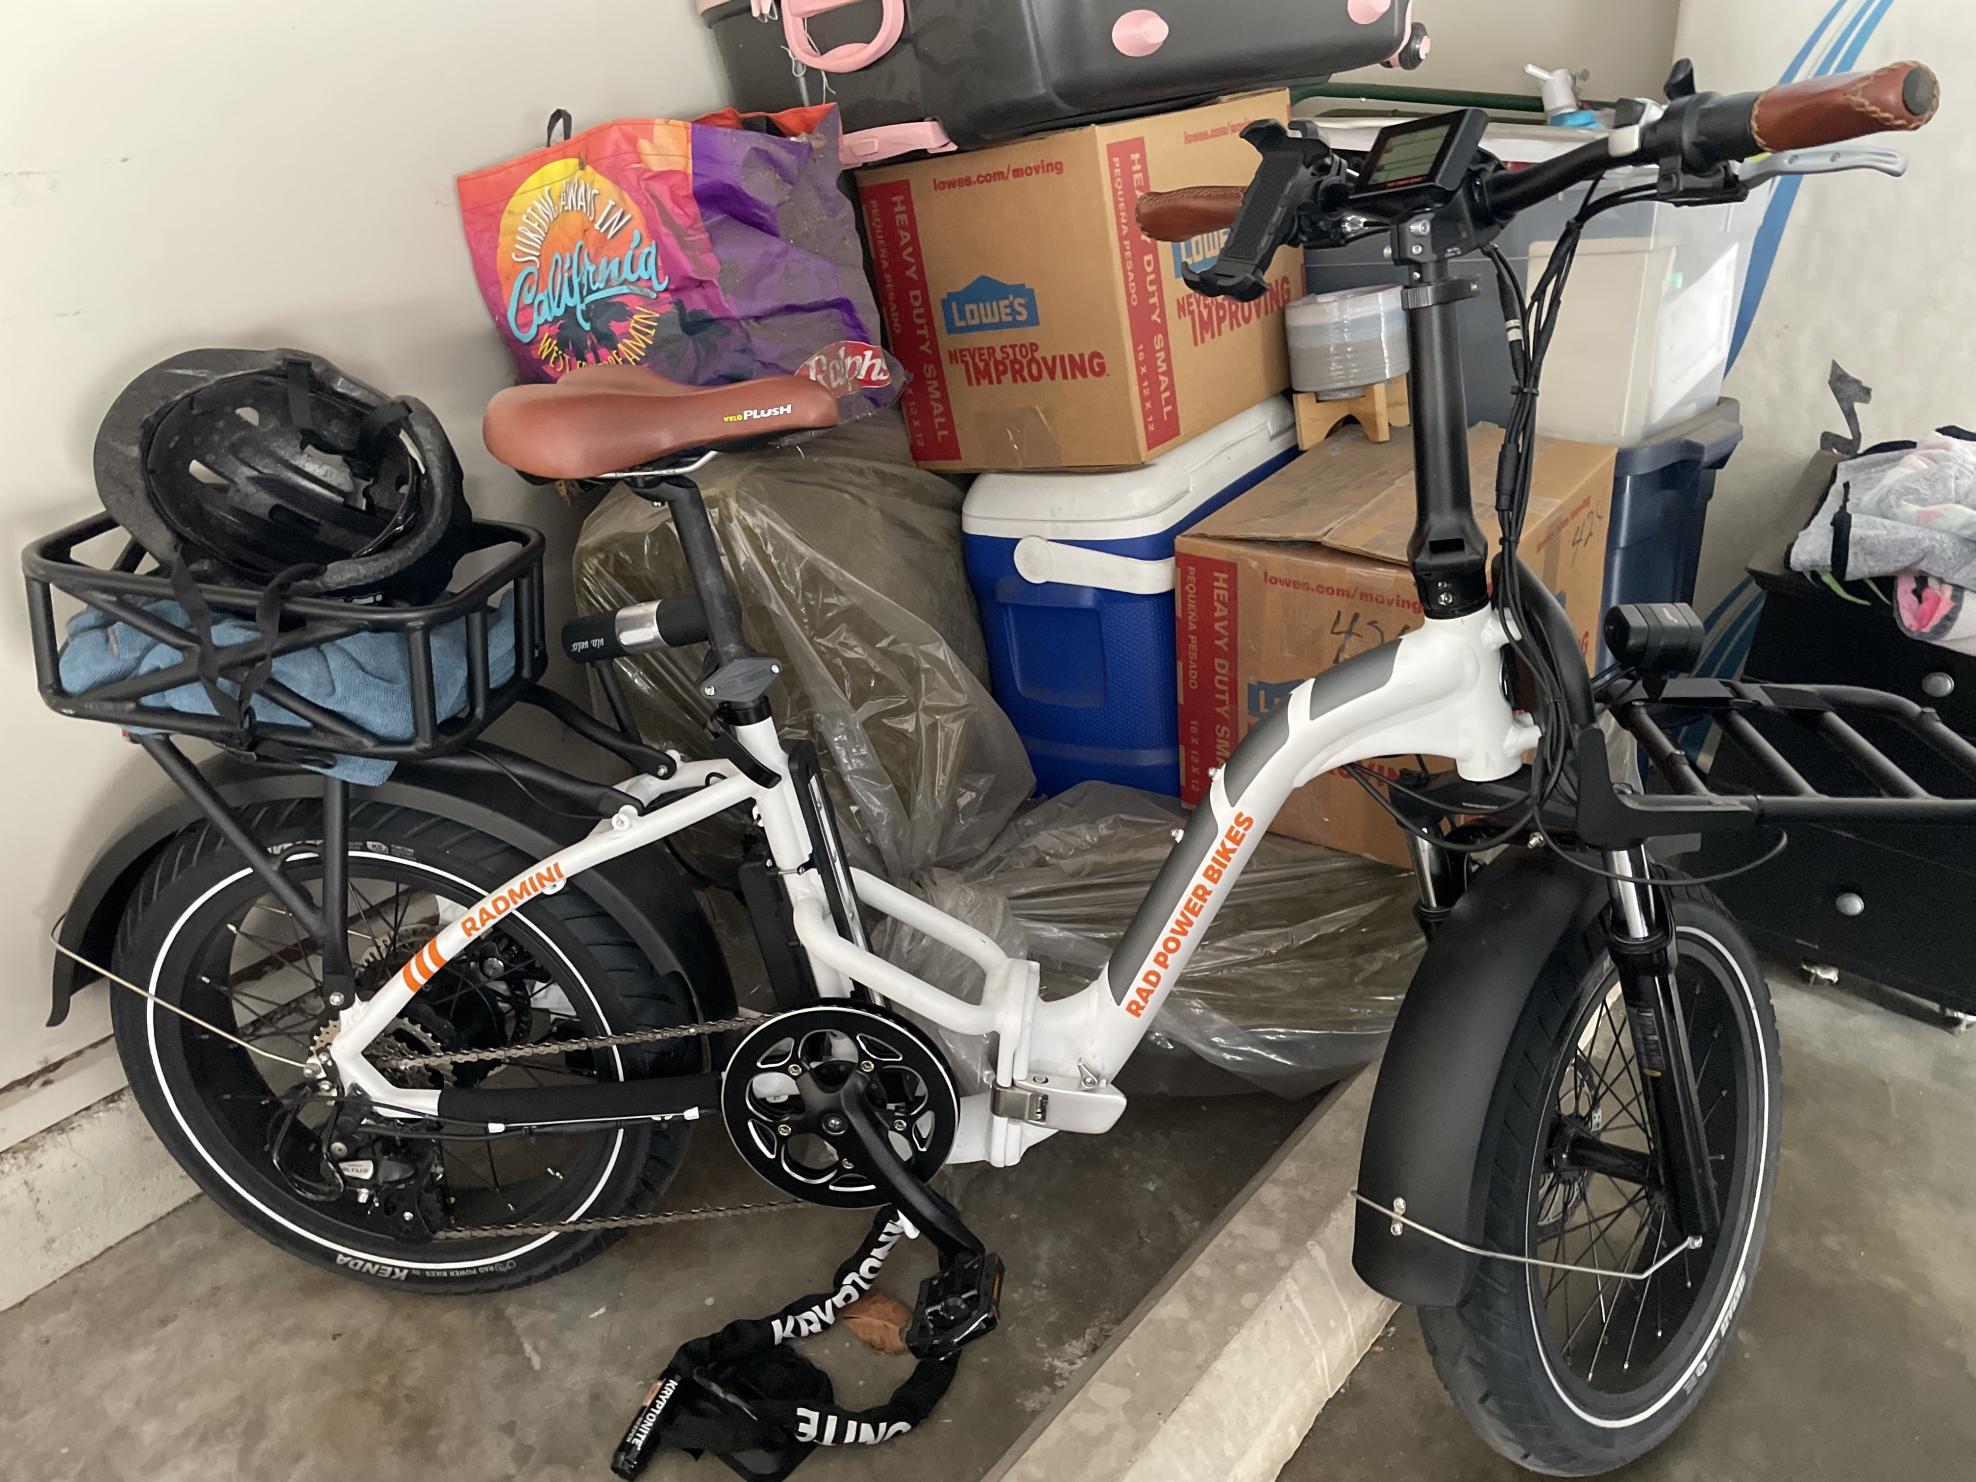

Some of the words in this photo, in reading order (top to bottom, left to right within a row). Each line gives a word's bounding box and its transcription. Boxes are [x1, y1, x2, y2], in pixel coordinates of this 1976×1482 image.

[933, 160, 1064, 192] lowes.com/moving
[594, 199, 632, 240] IN
[1123, 240, 1138, 307] PESADO
[884, 274, 902, 334] PESADO
[892, 194, 919, 280] HEAVY
[909, 290, 933, 355] DUTY
[924, 363, 949, 443] SMALL
[951, 294, 1029, 327] LOWE'S
[537, 333, 571, 373] WEST
[948, 345, 1001, 365] NEVER
[1001, 342, 1040, 361] STOP
[1143, 254, 1162, 324] DUTY
[1153, 333, 1173, 421] SMALL
[723, 414, 743, 423] VELO
[743, 404, 792, 421] PLUSH
[1213, 571, 1229, 652] HEAVY
[1264, 571, 1423, 614] lowes.com/moving
[571, 640, 590, 652] velo
[591, 638, 605, 647] via
[1188, 634, 1199, 690] PESADO
[1214, 657, 1230, 719] DUTY
[461, 862, 564, 938] RADMINI
[1125, 969, 1162, 1019] RAD
[1153, 883, 1213, 970] POWER
[1202, 811, 1254, 885] BIKES
[336, 1253, 410, 1281] KENDA
[425, 1269, 448, 1278] BIKES
[449, 1267, 477, 1277] POWER
[478, 1265, 495, 1274] RAD
[631, 1379, 679, 1449] KRYPTONITE
